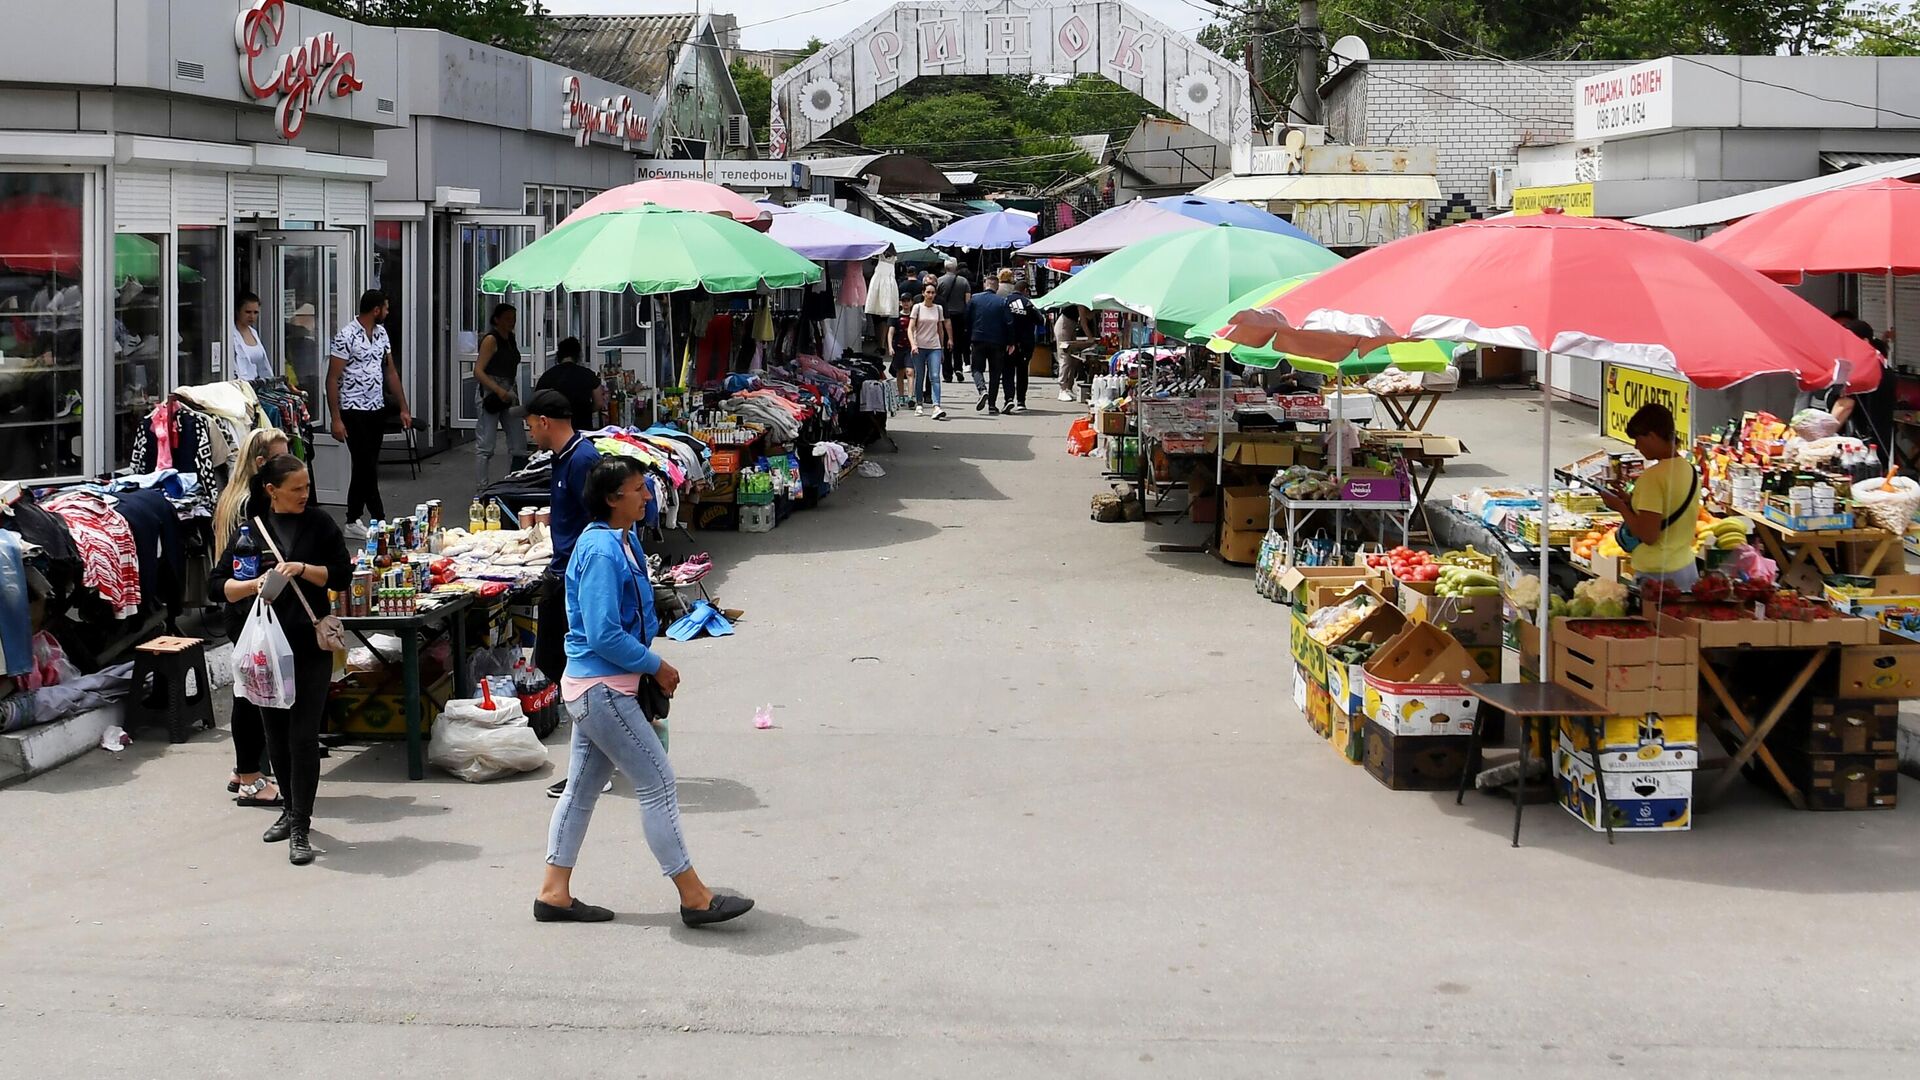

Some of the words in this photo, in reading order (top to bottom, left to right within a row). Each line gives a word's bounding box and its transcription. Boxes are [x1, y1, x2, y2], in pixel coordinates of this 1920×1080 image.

[868, 15, 1155, 82] РИНОК
[1584, 78, 1624, 106] ПРОДАЖА
[1630, 69, 1662, 97] ОБМЕН
[1597, 109, 1609, 130] 096
[1610, 107, 1620, 128] 20
[1632, 102, 1646, 125] 054
[638, 167, 714, 180] Мобильные
[721, 168, 787, 182] телефоны
[1570, 192, 1592, 208] СИГАРЕТ
